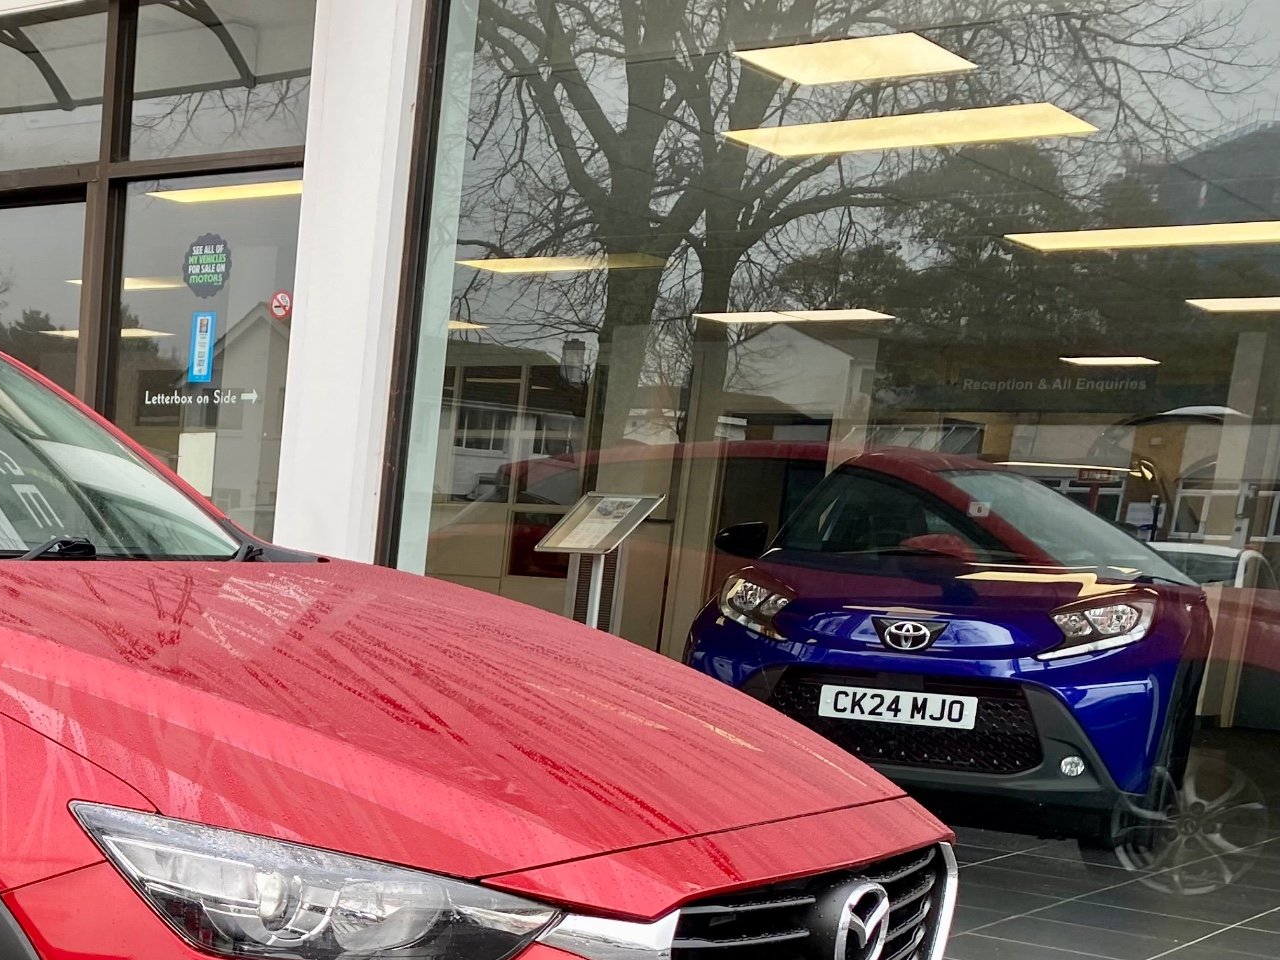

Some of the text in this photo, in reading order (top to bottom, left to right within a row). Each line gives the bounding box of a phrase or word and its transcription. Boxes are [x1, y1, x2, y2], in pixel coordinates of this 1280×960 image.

[192, 244, 224, 255] SEE ALL OF
[189, 254, 226, 264] MY VEHICLES
[188, 263, 226, 274] FOR SALE ON
[963, 378, 1147, 392] Reception & All Enquiries
[145, 390, 193, 404] Letterbox
[213, 390, 237, 404] Side
[833, 690, 965, 723] CK24 MJO
